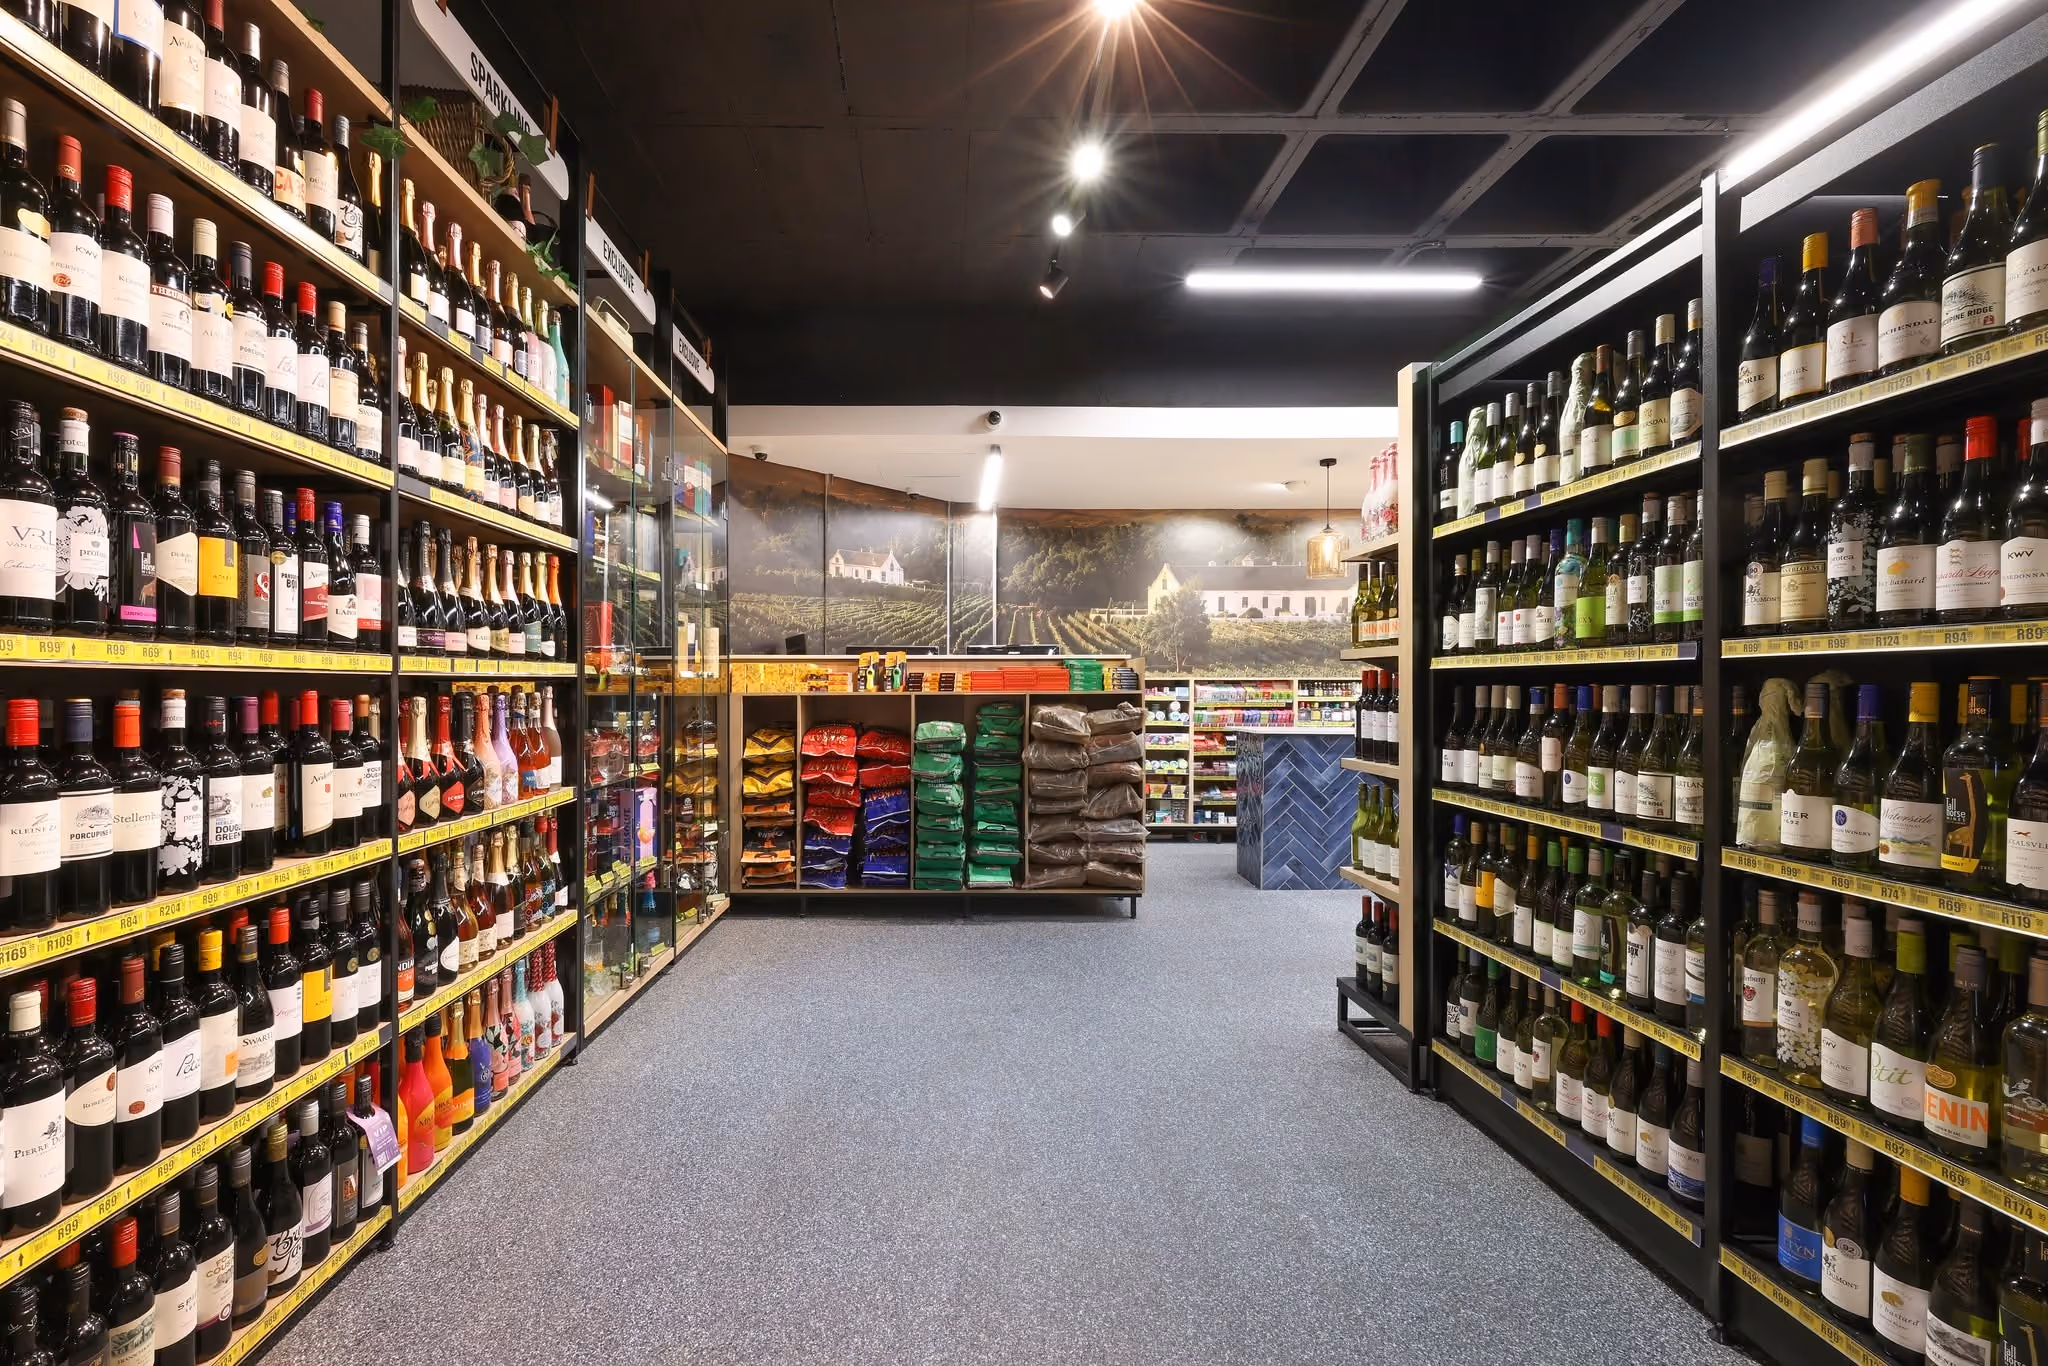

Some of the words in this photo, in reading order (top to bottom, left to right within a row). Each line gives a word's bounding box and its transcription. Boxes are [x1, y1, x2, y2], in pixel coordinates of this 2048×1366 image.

[603, 239, 636, 294] EXCLUSIVE
[2023, 263, 2048, 276] ZALZ
[1968, 305, 1994, 316] RIDGE
[678, 337, 701, 375] EXCLUSIVE
[1967, 352, 1991, 368] R84
[2007, 550, 2033, 560] KWV
[1967, 564, 2000, 579] Leap
[1889, 577, 1925, 586] bastard
[1944, 632, 1966, 643] R94
[2017, 627, 2042, 640] R89
[39, 641, 61, 653] R99
[1787, 640, 1804, 650] R94
[1828, 638, 1846, 649] R99
[1875, 636, 1900, 647] R124
[107, 643, 126, 655] R99
[142, 646, 160, 658] R69
[1882, 807, 1936, 825] Waterside
[69, 829, 108, 841] PORCUPINE
[1781, 865, 1798, 877] R99
[1831, 876, 1850, 888] R89
[1880, 886, 1899, 900] R74
[159, 902, 181, 917] R204
[1938, 899, 1961, 913] R69
[120, 915, 138, 929] R84
[2002, 911, 2031, 928] R119
[46, 934, 73, 952] R109
[1741, 1070, 1758, 1085] R89
[1783, 1090, 1800, 1106] R99
[1926, 1090, 1989, 1133] ENIN
[374, 1125, 388, 1137] VIP
[14, 1142, 50, 1159] PIERRE
[191, 1140, 207, 1157] R92
[1884, 1139, 1906, 1158] R92
[157, 1159, 175, 1178] R99
[1941, 1166, 1965, 1187] R69
[98, 1196, 117, 1215] R89
[2003, 1196, 2034, 1220] R174
[57, 1219, 79, 1240] R99
